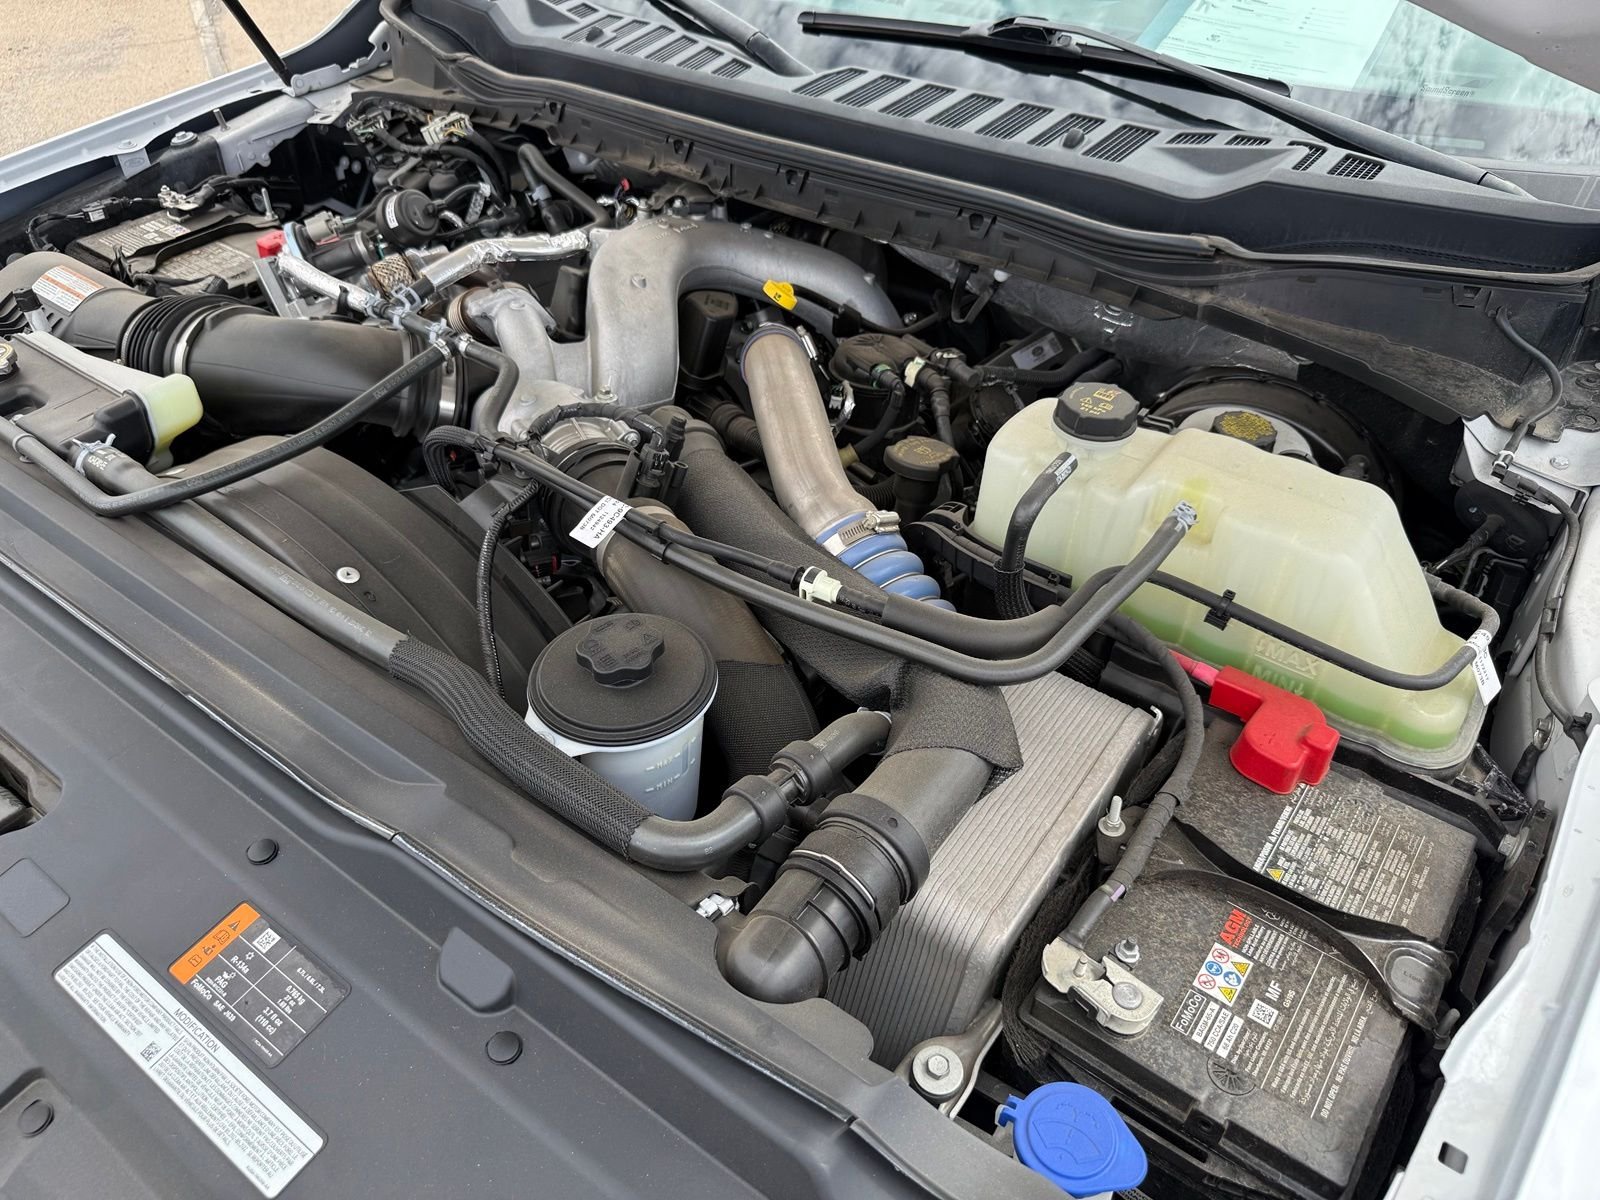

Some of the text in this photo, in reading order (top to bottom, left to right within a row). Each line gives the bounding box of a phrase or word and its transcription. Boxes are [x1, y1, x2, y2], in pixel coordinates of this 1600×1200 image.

[1273, 647, 1320, 677] MAX
[1217, 908, 1246, 945] AGM
[1232, 916, 1252, 948] TECHNOLOGY
[230, 954, 250, 974] R-134a
[190, 978, 213, 1000] FoMoCo
[214, 975, 228, 988] PAG
[1264, 979, 1284, 1001] MF
[212, 999, 225, 1011] SAE
[295, 994, 306, 1006] kg
[262, 1006, 273, 1017] 3.7
[1175, 992, 1201, 1032] FoMoCo
[173, 1007, 221, 1053] MODIFICATION
[1211, 1010, 1229, 1038] CCA/SAE
